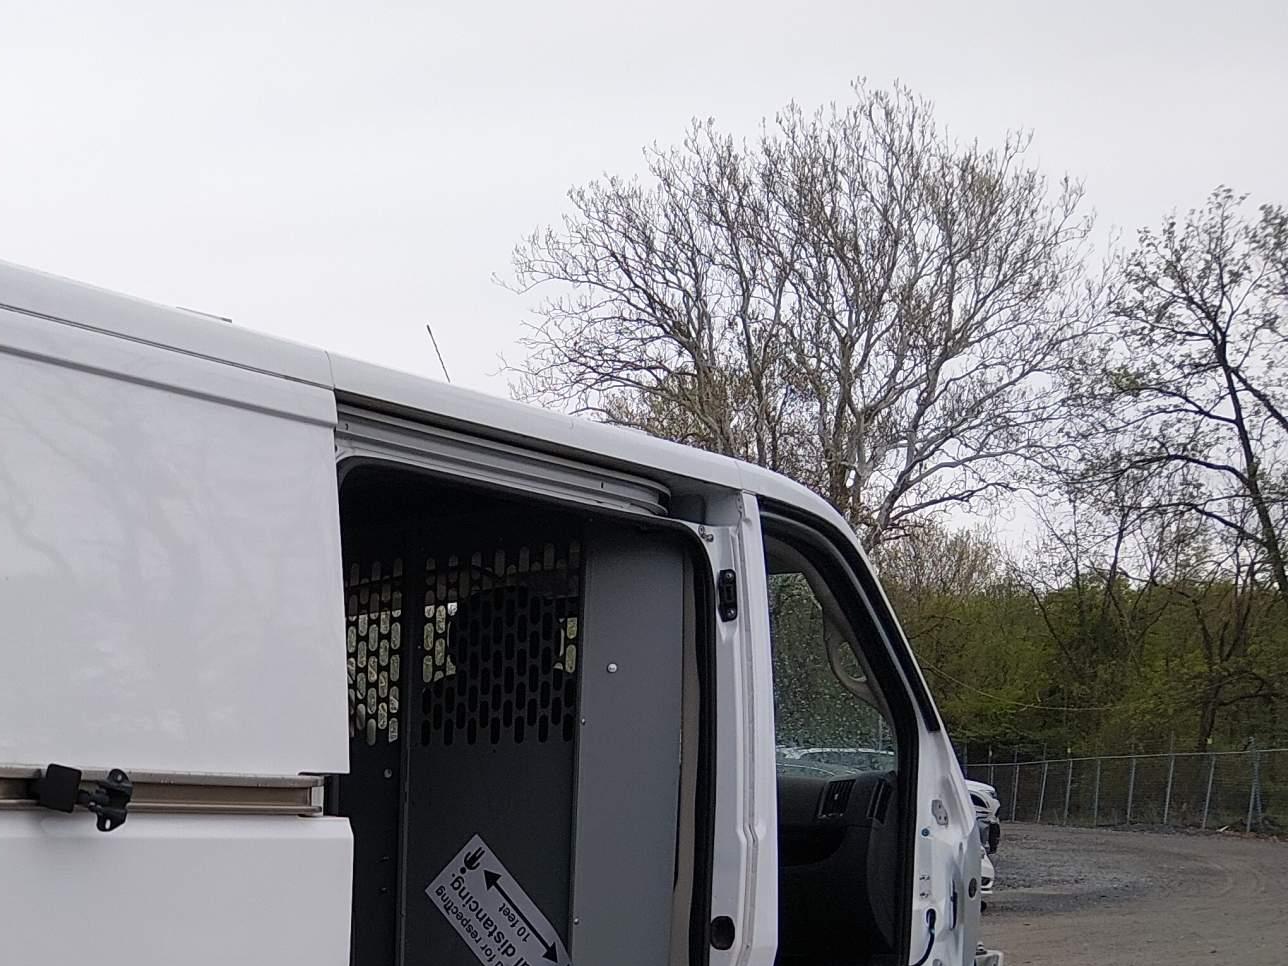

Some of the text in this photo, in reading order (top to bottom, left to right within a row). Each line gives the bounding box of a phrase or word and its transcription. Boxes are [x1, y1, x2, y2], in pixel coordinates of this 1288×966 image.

[435, 885, 481, 943] respecting
[450, 873, 515, 956] distancing.
[498, 902, 530, 942] 10 feet
[479, 943, 496, 962] for
